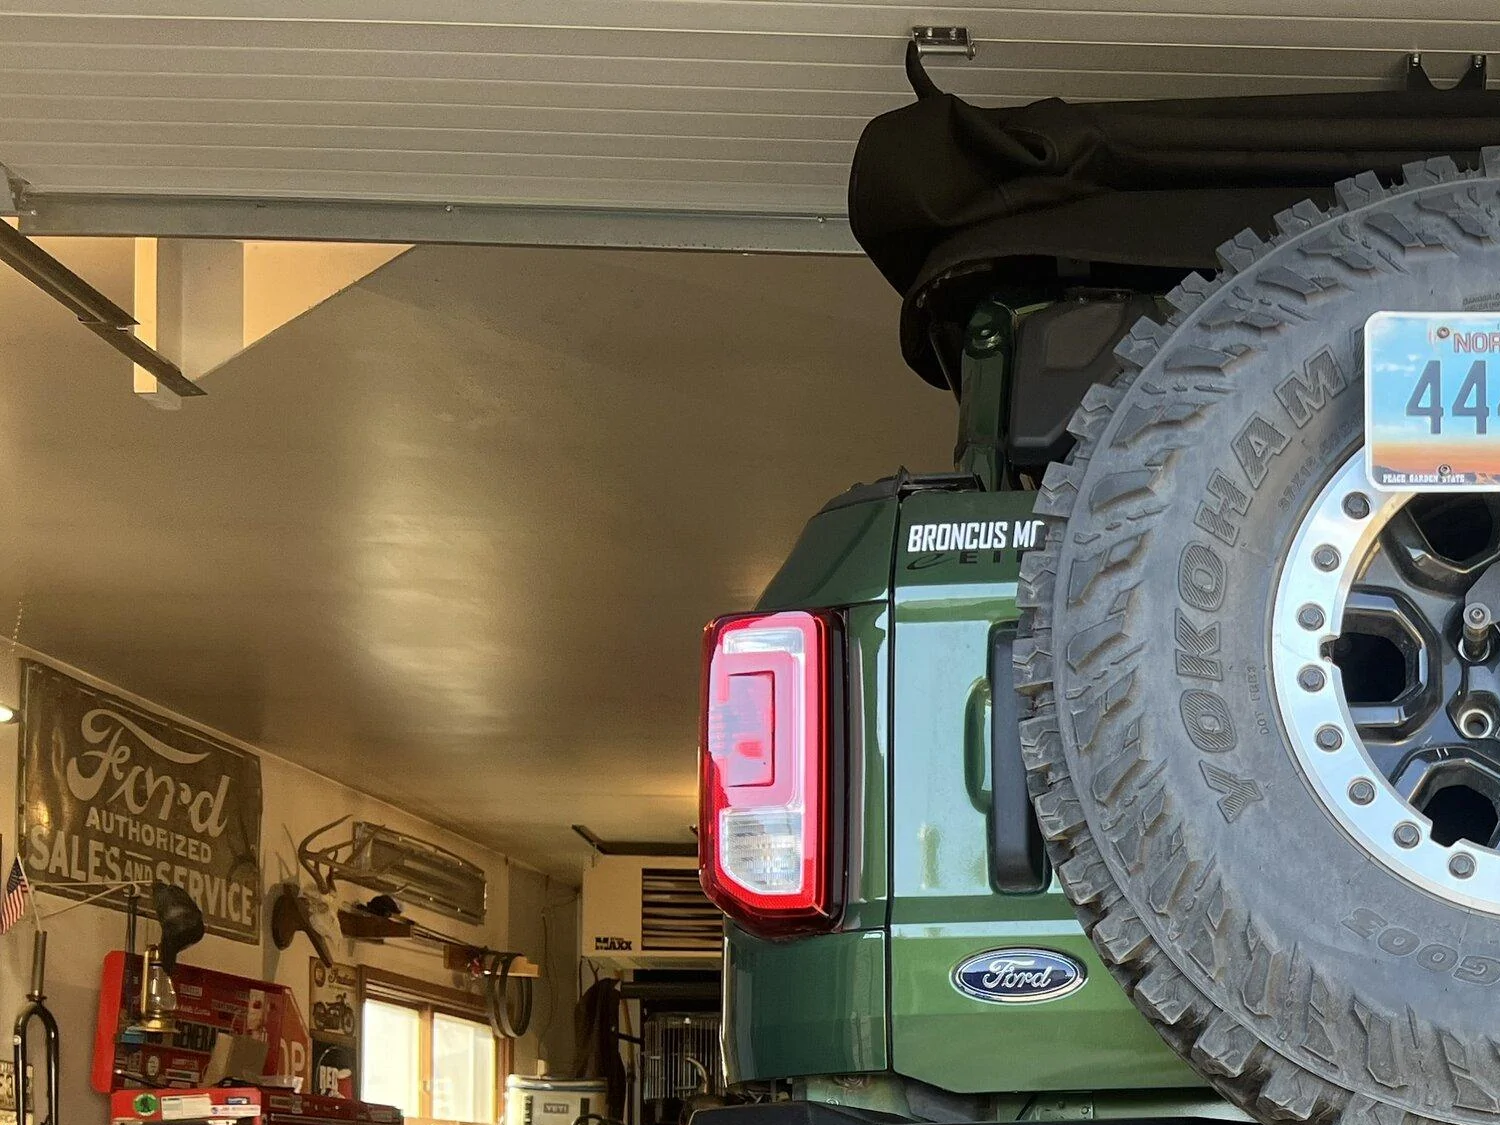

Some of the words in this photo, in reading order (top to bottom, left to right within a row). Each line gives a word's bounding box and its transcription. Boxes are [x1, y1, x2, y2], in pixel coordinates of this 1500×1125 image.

[1382, 473, 1407, 484] PEACE
[1409, 473, 1438, 484] GARDEN
[1441, 473, 1465, 484] STATE
[907, 521, 1008, 552] BRONCUS
[1173, 325, 1364, 824] YOKOHAM
[67, 708, 231, 837] Ford
[28, 825, 123, 884] SALES
[123, 860, 153, 886] AND
[85, 807, 212, 864] AUTHORIZED
[982, 959, 1052, 991] Ford
